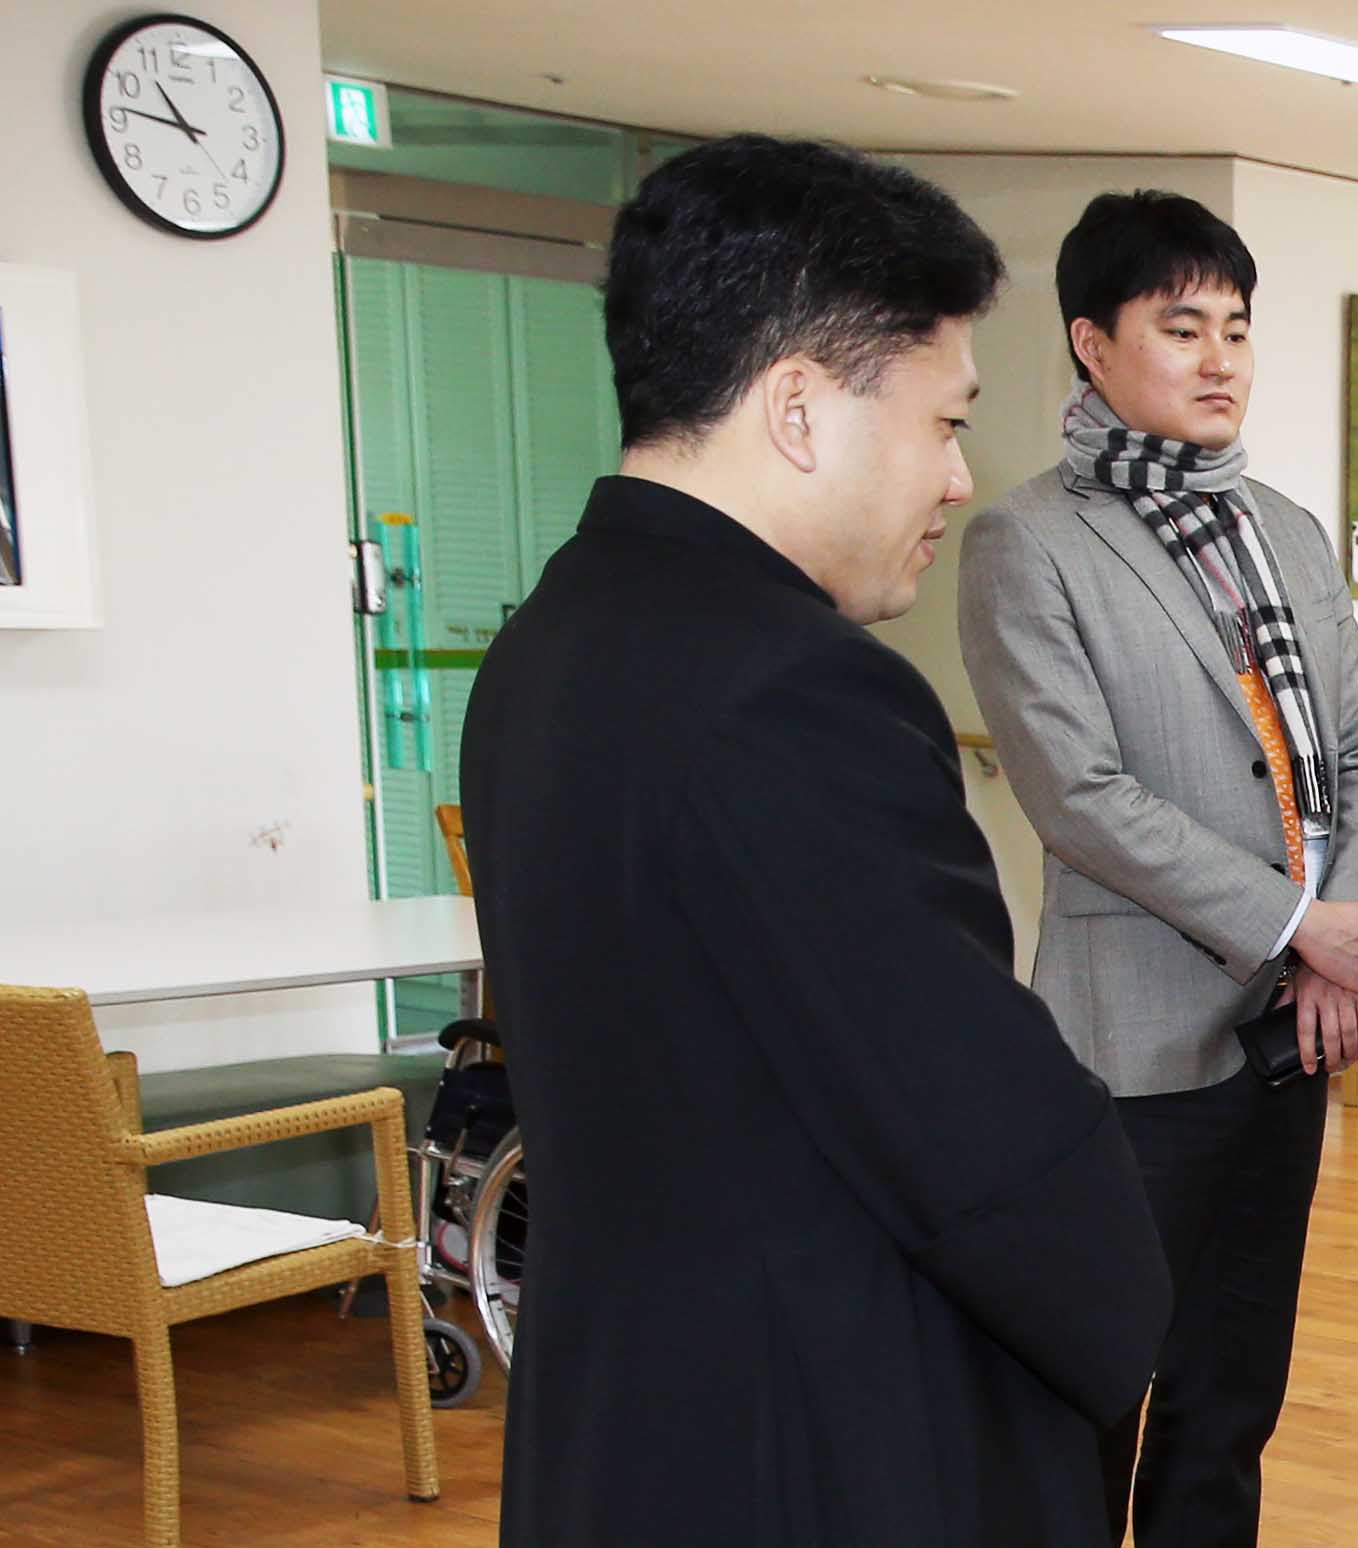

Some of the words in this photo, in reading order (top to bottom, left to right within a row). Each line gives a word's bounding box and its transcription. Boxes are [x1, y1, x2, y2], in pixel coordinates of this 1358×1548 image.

[139, 48, 159, 74] 11
[206, 60, 217, 83] 1
[116, 72, 140, 99] 10
[228, 88, 246, 113] 2
[110, 109, 128, 133] 9
[242, 127, 258, 151] 3
[124, 145, 142, 170] 8
[231, 160, 249, 185] 4
[152, 175, 168, 200] 7
[213, 183, 230, 209] 5
[184, 190, 201, 215] 6
